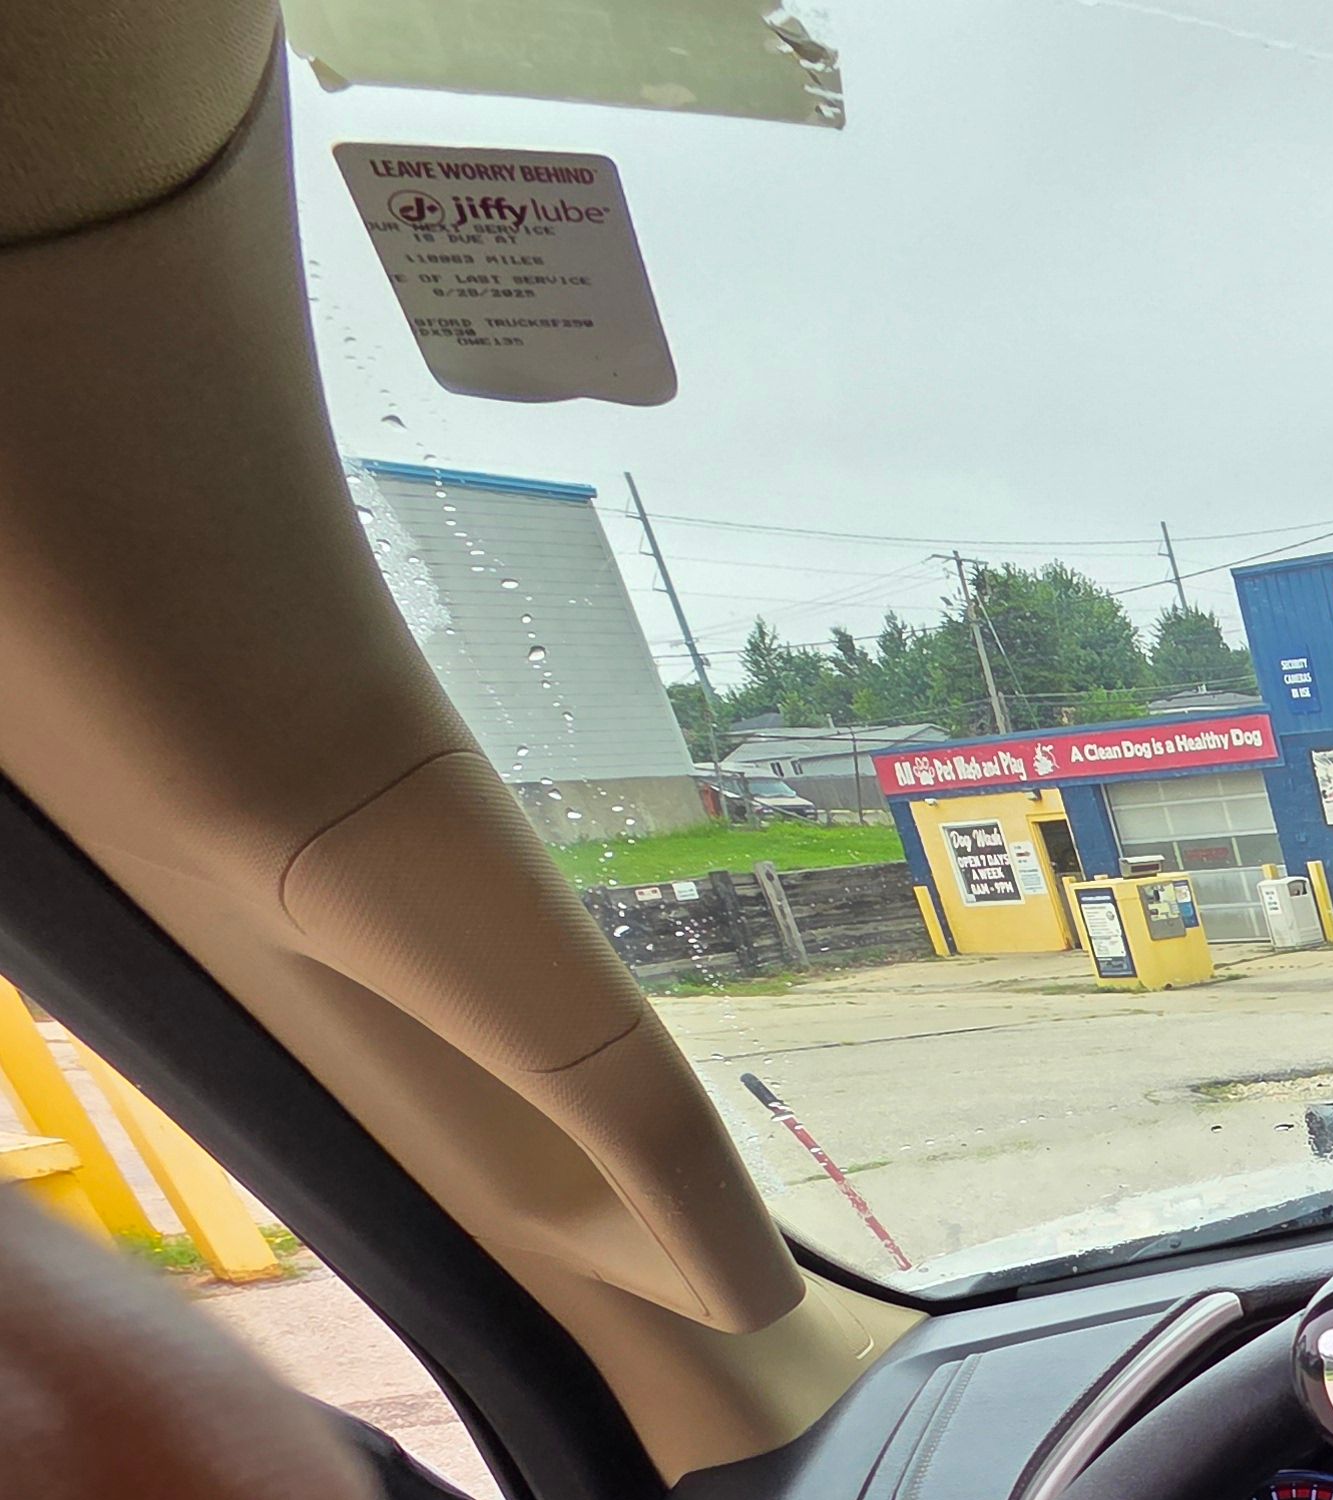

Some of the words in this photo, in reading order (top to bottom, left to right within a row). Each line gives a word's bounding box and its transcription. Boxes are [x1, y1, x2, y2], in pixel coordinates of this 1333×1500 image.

[370, 159, 437, 179] LEAVE
[438, 162, 517, 182] WORRY
[519, 165, 595, 184] BEHIND
[452, 196, 528, 227] jiffy
[530, 198, 607, 223] lube
[513, 276, 593, 285] SERVICE
[1284, 672, 1312, 685] CAMERAS
[1070, 745, 1084, 762] A
[1084, 743, 1122, 761] Clean
[1121, 740, 1151, 759] Dog
[1151, 737, 1165, 755] is
[1165, 740, 1176, 753] a
[1175, 730, 1229, 753] Healthy
[1230, 728, 1263, 747] Dog
[894, 761, 916, 786] All
[933, 758, 956, 782] Pet
[953, 755, 982, 781] Wash
[982, 755, 1001, 777] and
[998, 751, 1028, 781] Play
[949, 830, 972, 852] Dog
[972, 828, 1003, 848] Wash
[957, 856, 980, 868] OPEN
[980, 854, 986, 867] 7
[986, 854, 1011, 867] DAYS
[971, 868, 978, 880] A
[978, 867, 1005, 880] WEEK
[994, 881, 1014, 894] 9PM
